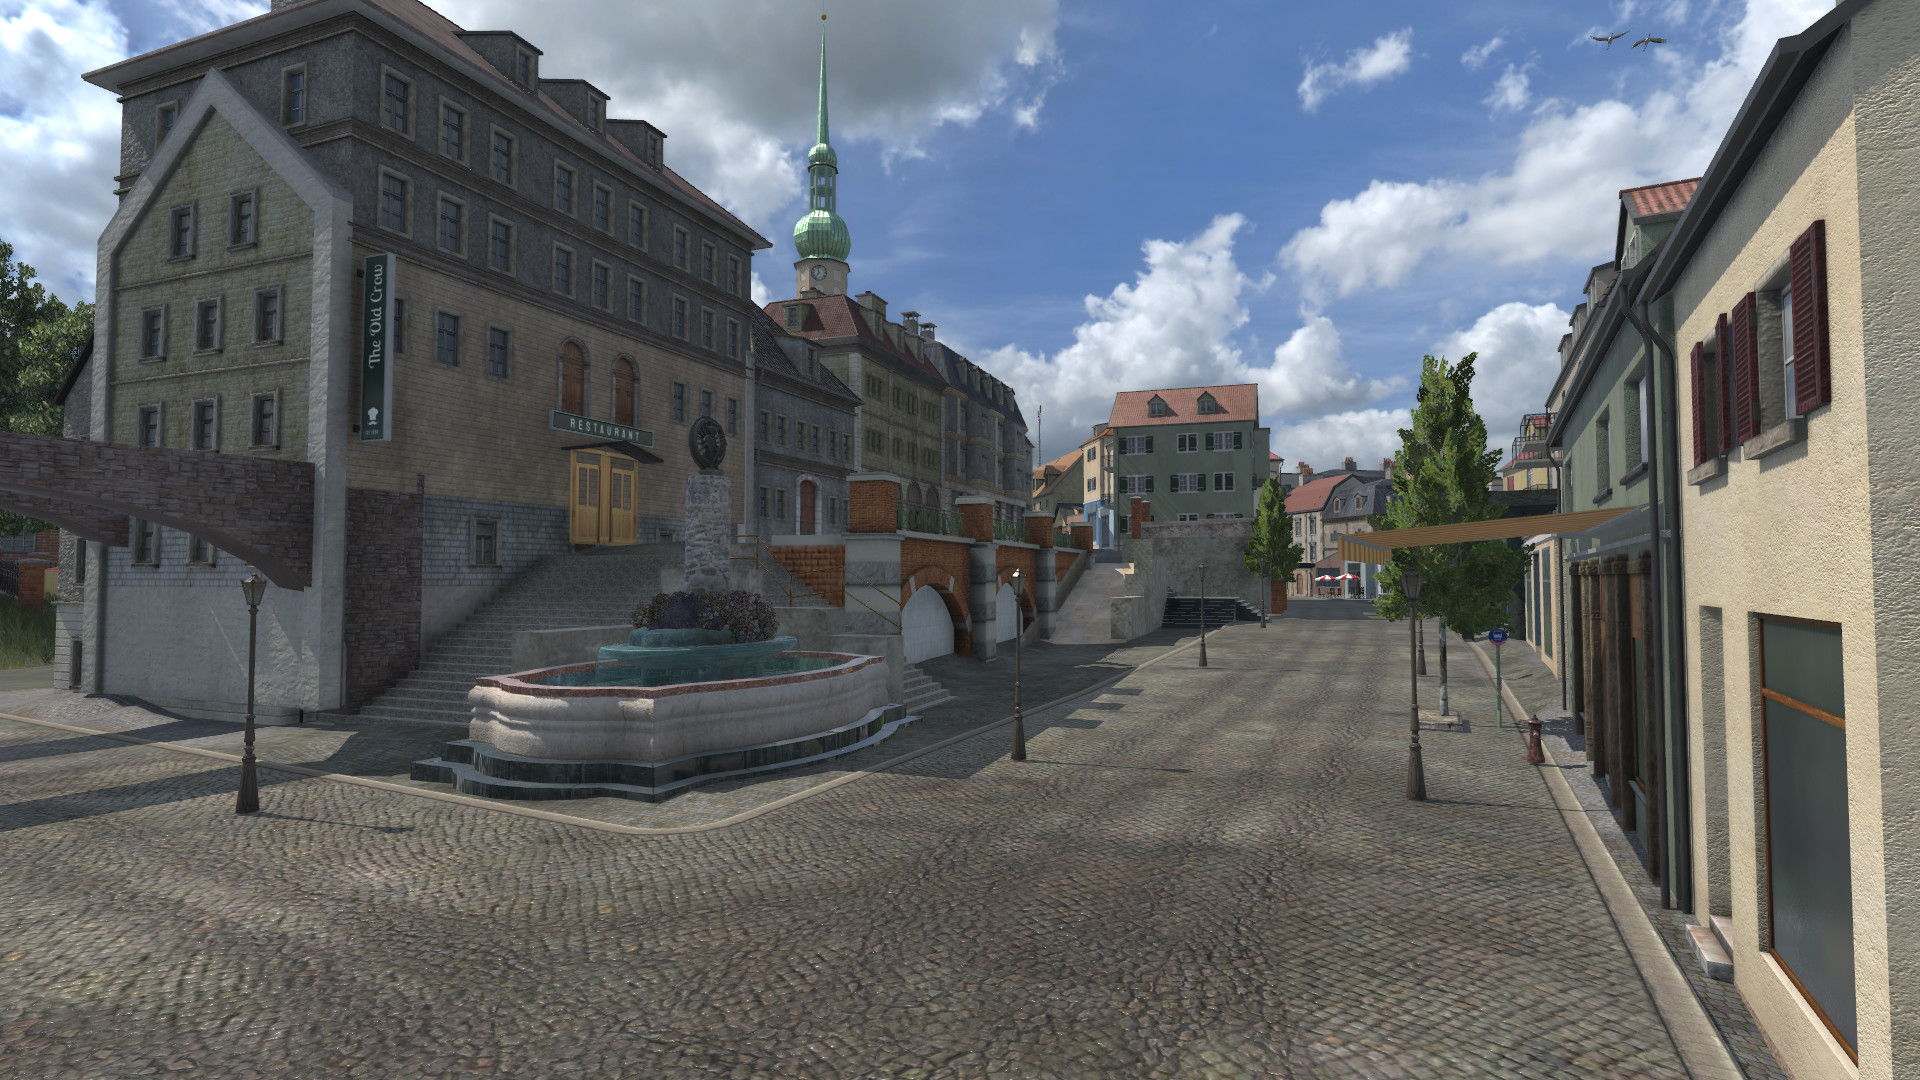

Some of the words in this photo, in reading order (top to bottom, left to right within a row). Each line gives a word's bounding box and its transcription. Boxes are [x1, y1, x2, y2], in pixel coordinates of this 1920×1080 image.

[370, 264, 383, 303] Crow
[370, 307, 382, 337] Old
[368, 340, 381, 369] The
[570, 418, 639, 441] RESTAURANT
